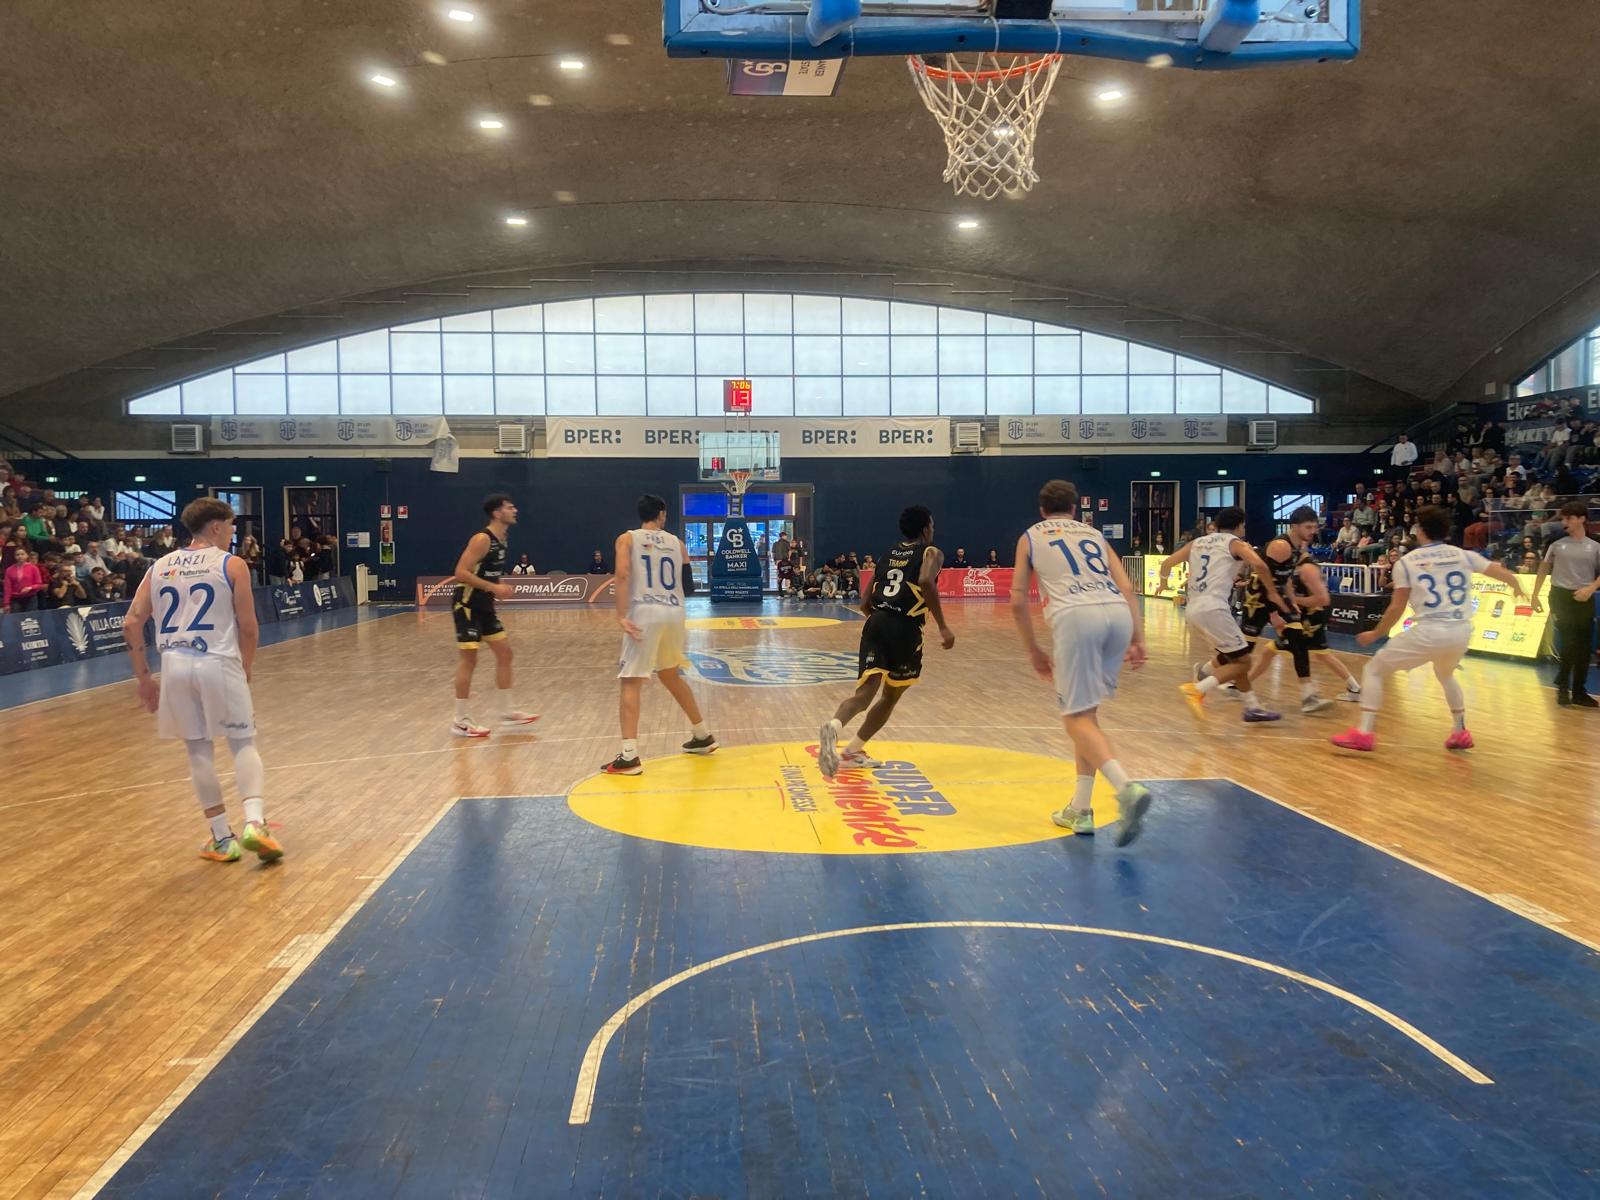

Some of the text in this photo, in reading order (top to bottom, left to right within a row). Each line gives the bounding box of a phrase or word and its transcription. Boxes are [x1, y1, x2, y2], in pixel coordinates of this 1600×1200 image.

[732, 390, 750, 406] 13
[167, 554, 206, 567] LANZI
[641, 554, 675, 590] 10
[1048, 538, 1109, 577] 18
[1196, 554, 1210, 582] 3
[514, 581, 581, 594] PRIMAVERA
[883, 568, 904, 597] 3
[1417, 570, 1467, 609] 38
[159, 582, 216, 635] 22
[89, 617, 111, 633] VILLA
[871, 760, 958, 816] SUPER
